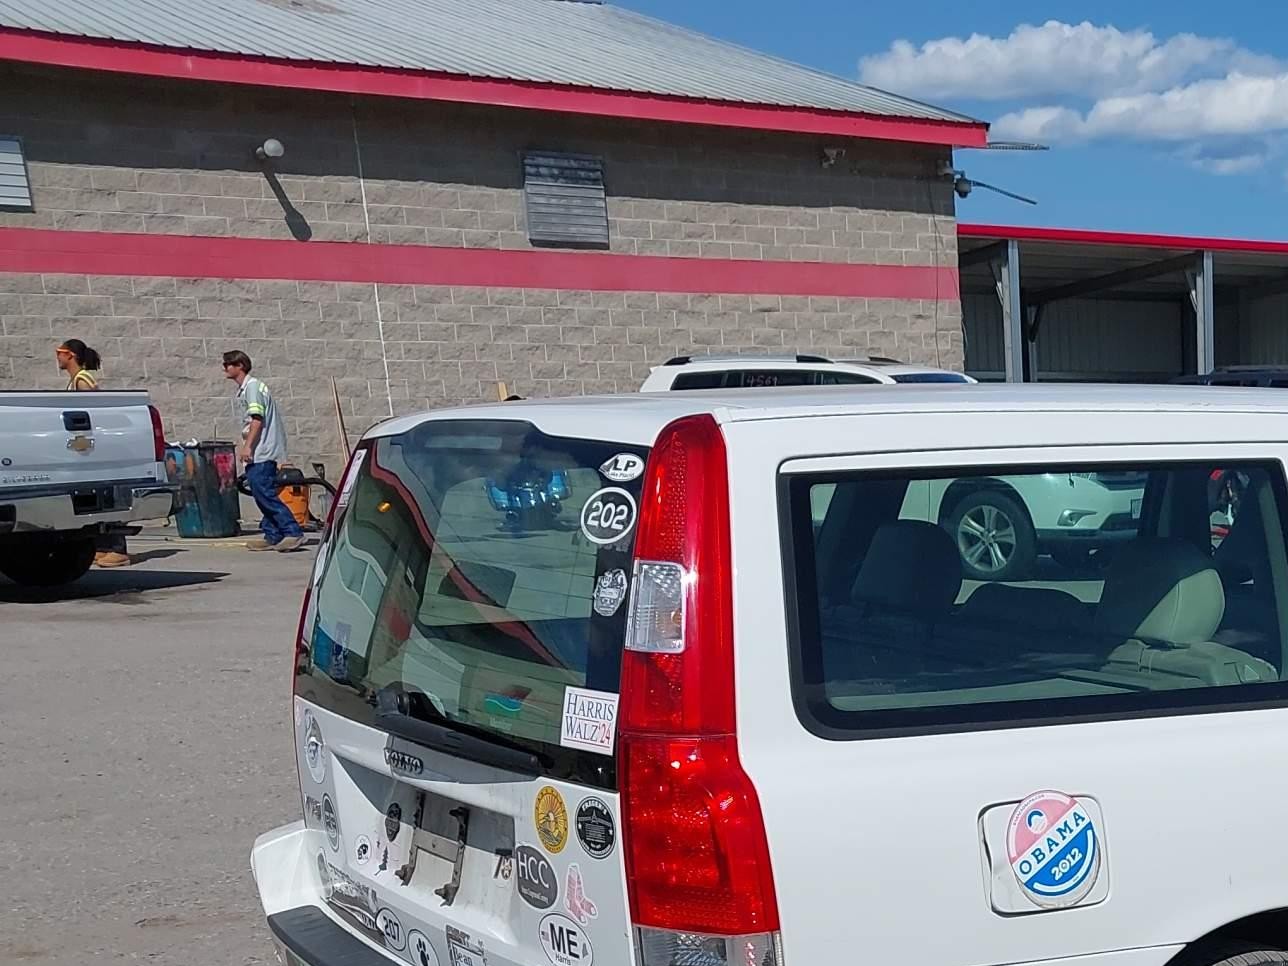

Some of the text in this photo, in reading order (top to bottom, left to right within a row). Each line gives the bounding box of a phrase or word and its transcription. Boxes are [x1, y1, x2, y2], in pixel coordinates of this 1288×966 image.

[613, 458, 637, 471] LP
[586, 500, 628, 530] 202
[566, 693, 614, 722] HARRIS
[1019, 811, 1086, 875] OBAMA
[518, 851, 550, 889] HCC
[1051, 848, 1083, 880] 2012
[383, 915, 400, 942] 207
[549, 922, 580, 959] ME
[556, 953, 572, 966] Harris
